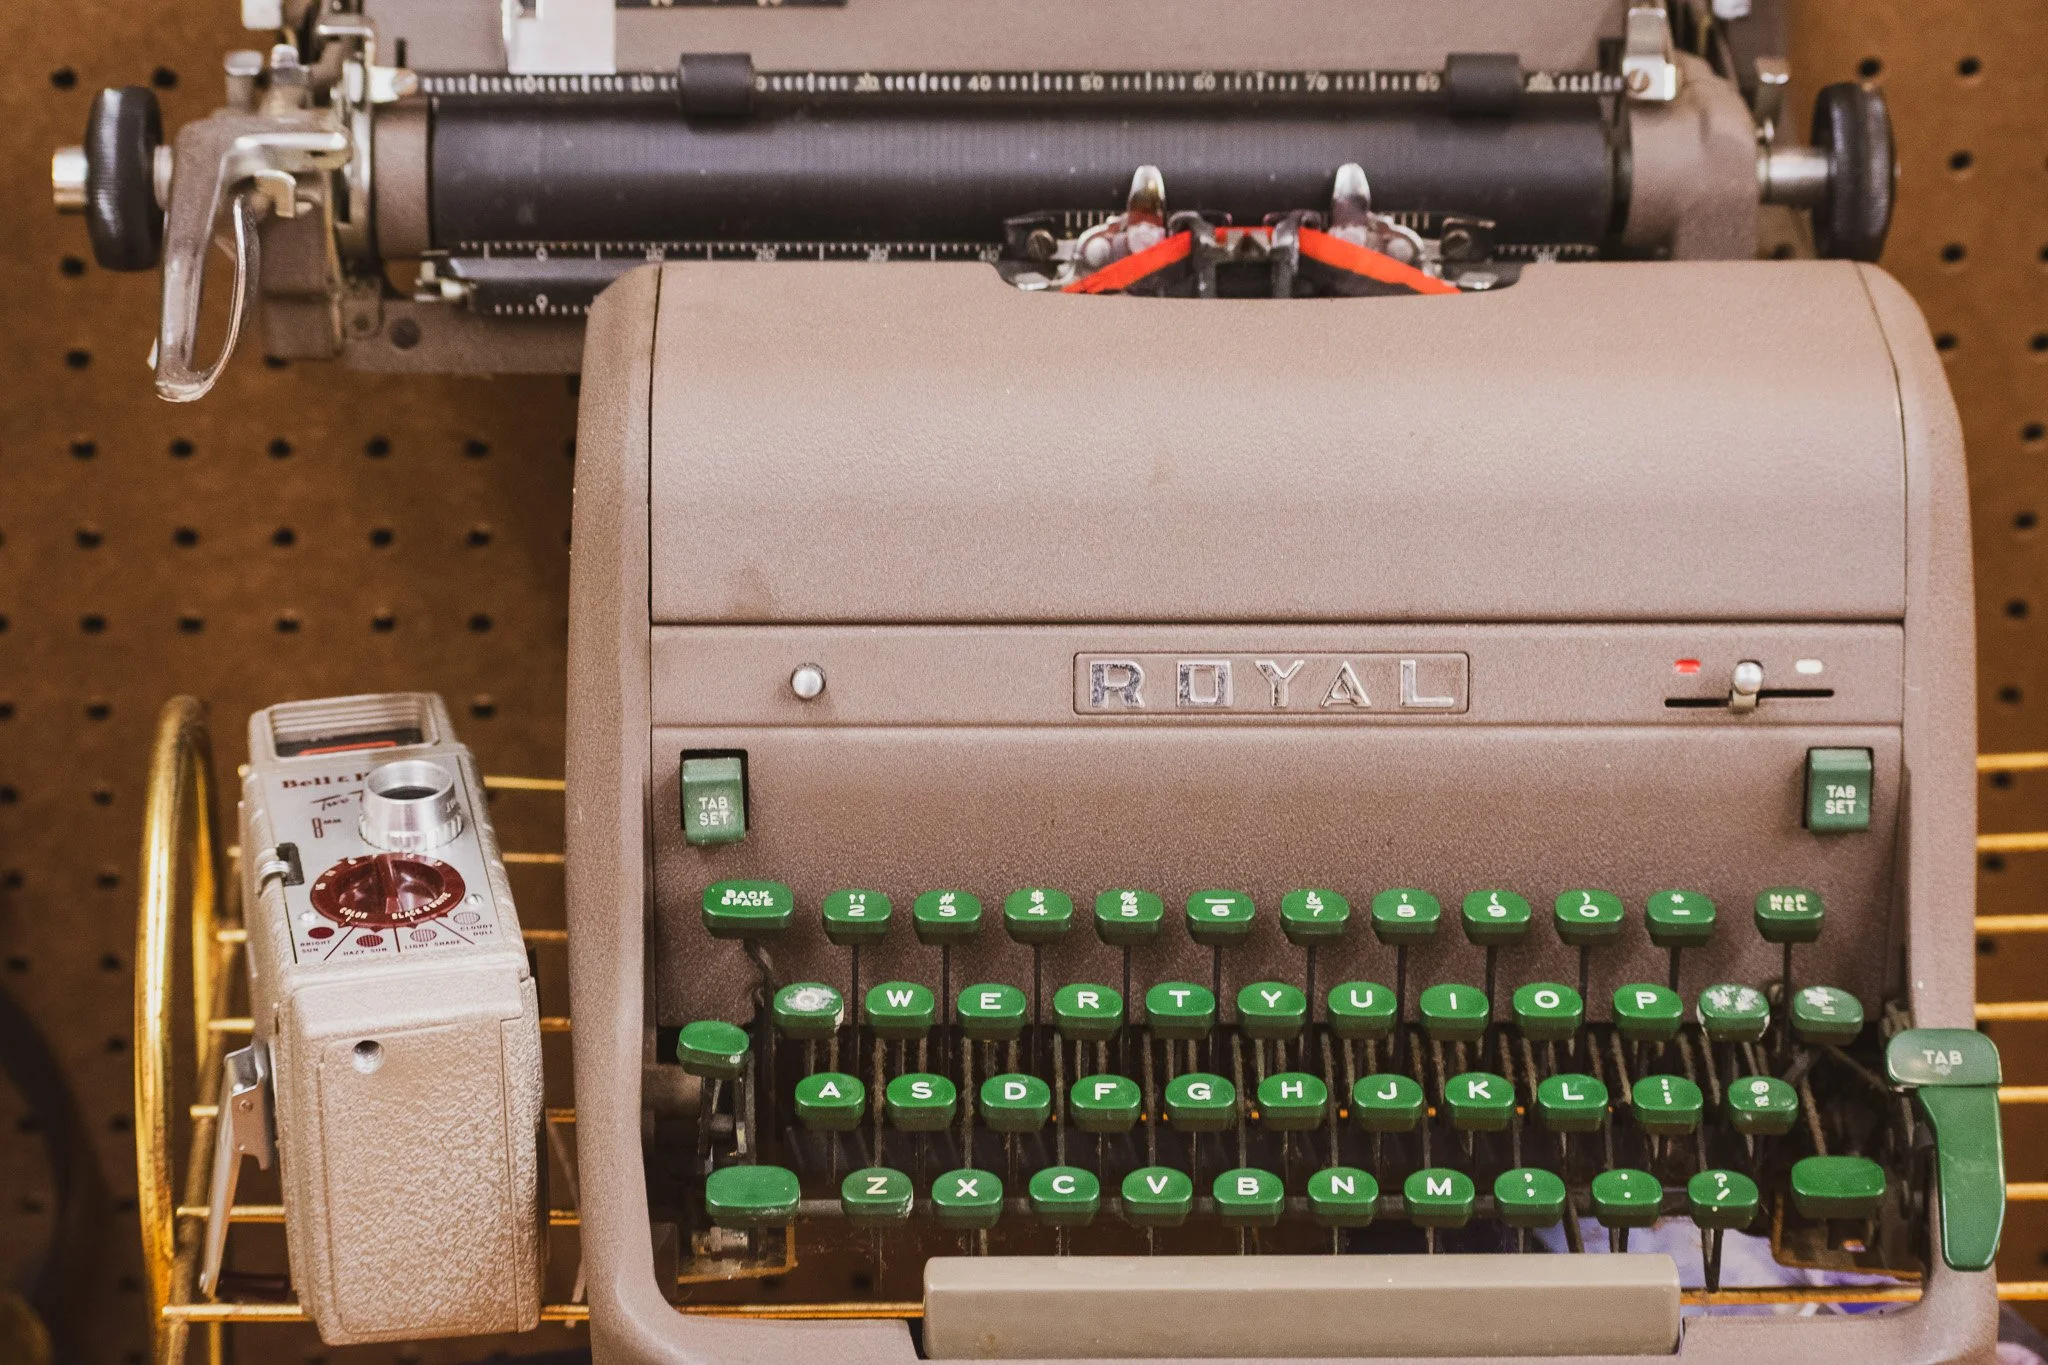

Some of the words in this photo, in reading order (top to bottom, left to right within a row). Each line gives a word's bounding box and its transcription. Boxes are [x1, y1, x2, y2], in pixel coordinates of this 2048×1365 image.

[1305, 74, 1329, 92] 70
[1089, 659, 1455, 709] ROYAL
[282, 776, 331, 788] Bell
[1825, 784, 1857, 799] TAB
[698, 796, 729, 811] TAB
[1825, 799, 1857, 815] SET
[699, 811, 730, 827] SET
[720, 896, 773, 907] SPACE
[724, 889, 769, 899] BACK
[940, 893, 955, 905] #
[1031, 890, 1044, 904] $
[1121, 892, 1137, 905] %
[1307, 892, 1321, 904] &
[1583, 892, 1590, 904] )
[339, 907, 368, 920] COLOR
[392, 907, 423, 920] BLACK
[848, 905, 865, 916] 2
[939, 903, 956, 916] 3
[1028, 903, 1047, 915] 4
[1122, 904, 1138, 916] 5
[1306, 903, 1323, 916] 7
[1397, 905, 1415, 917] 8
[1488, 904, 1506, 917] 9
[1580, 903, 1599, 917] 0
[887, 990, 913, 1007] W
[981, 993, 1001, 1009] E
[1078, 992, 1099, 1008] R
[1169, 990, 1190, 1007] T
[1261, 991, 1281, 1007] Y
[1351, 990, 1372, 1008] U
[1450, 993, 1457, 1009] I
[1535, 991, 1559, 1008] O
[1636, 992, 1657, 1009] P
[1922, 1048, 1964, 1067] TAB
[819, 1082, 840, 1098] A
[912, 1082, 932, 1098] S
[1005, 1082, 1026, 1099] D
[1095, 1083, 1116, 1100] F
[1188, 1083, 1211, 1100] G
[1282, 1081, 1302, 1098] H
[1378, 1082, 1397, 1099] J
[1469, 1081, 1491, 1098] K
[1562, 1083, 1584, 1100] L
[867, 1177, 887, 1194] Z
[956, 1179, 978, 1197] X
[1053, 1176, 1075, 1193] C
[1147, 1176, 1168, 1194] V
[1238, 1177, 1259, 1195] B
[1332, 1176, 1354, 1194] N
[1427, 1177, 1451, 1195] M
[1714, 1173, 1727, 1187] ?
[1717, 1186, 1730, 1200] /
